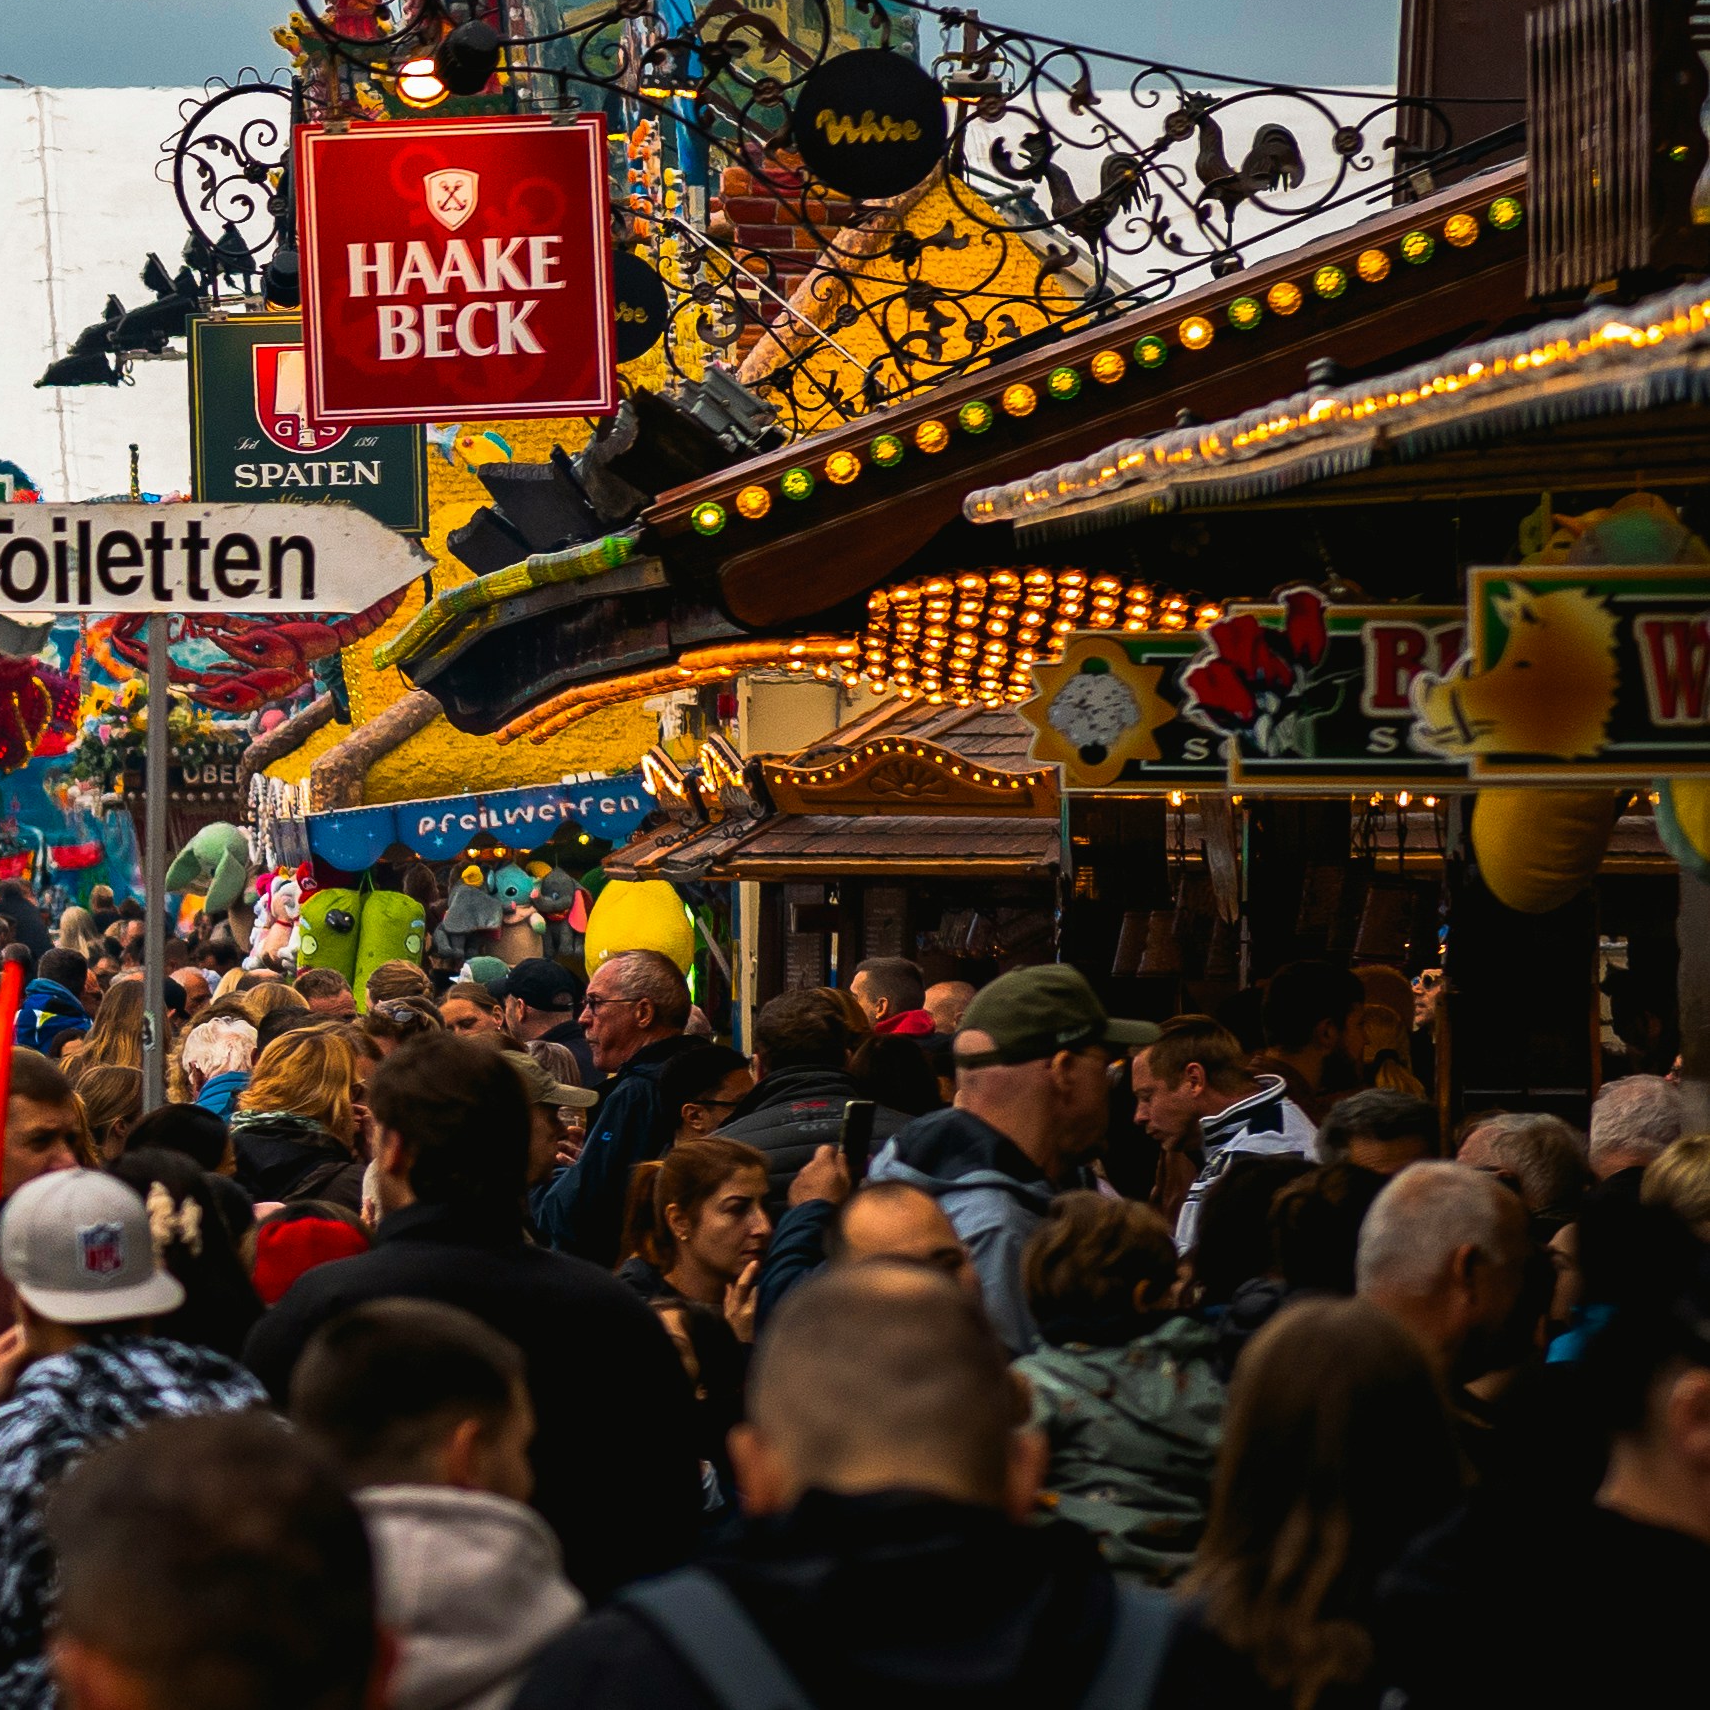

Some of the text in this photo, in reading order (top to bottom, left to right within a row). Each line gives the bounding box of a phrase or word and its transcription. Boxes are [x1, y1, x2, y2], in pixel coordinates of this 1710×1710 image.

[347, 235, 568, 298] HAAKE
[377, 299, 548, 361] BECK
[233, 460, 381, 489] SPATEN
